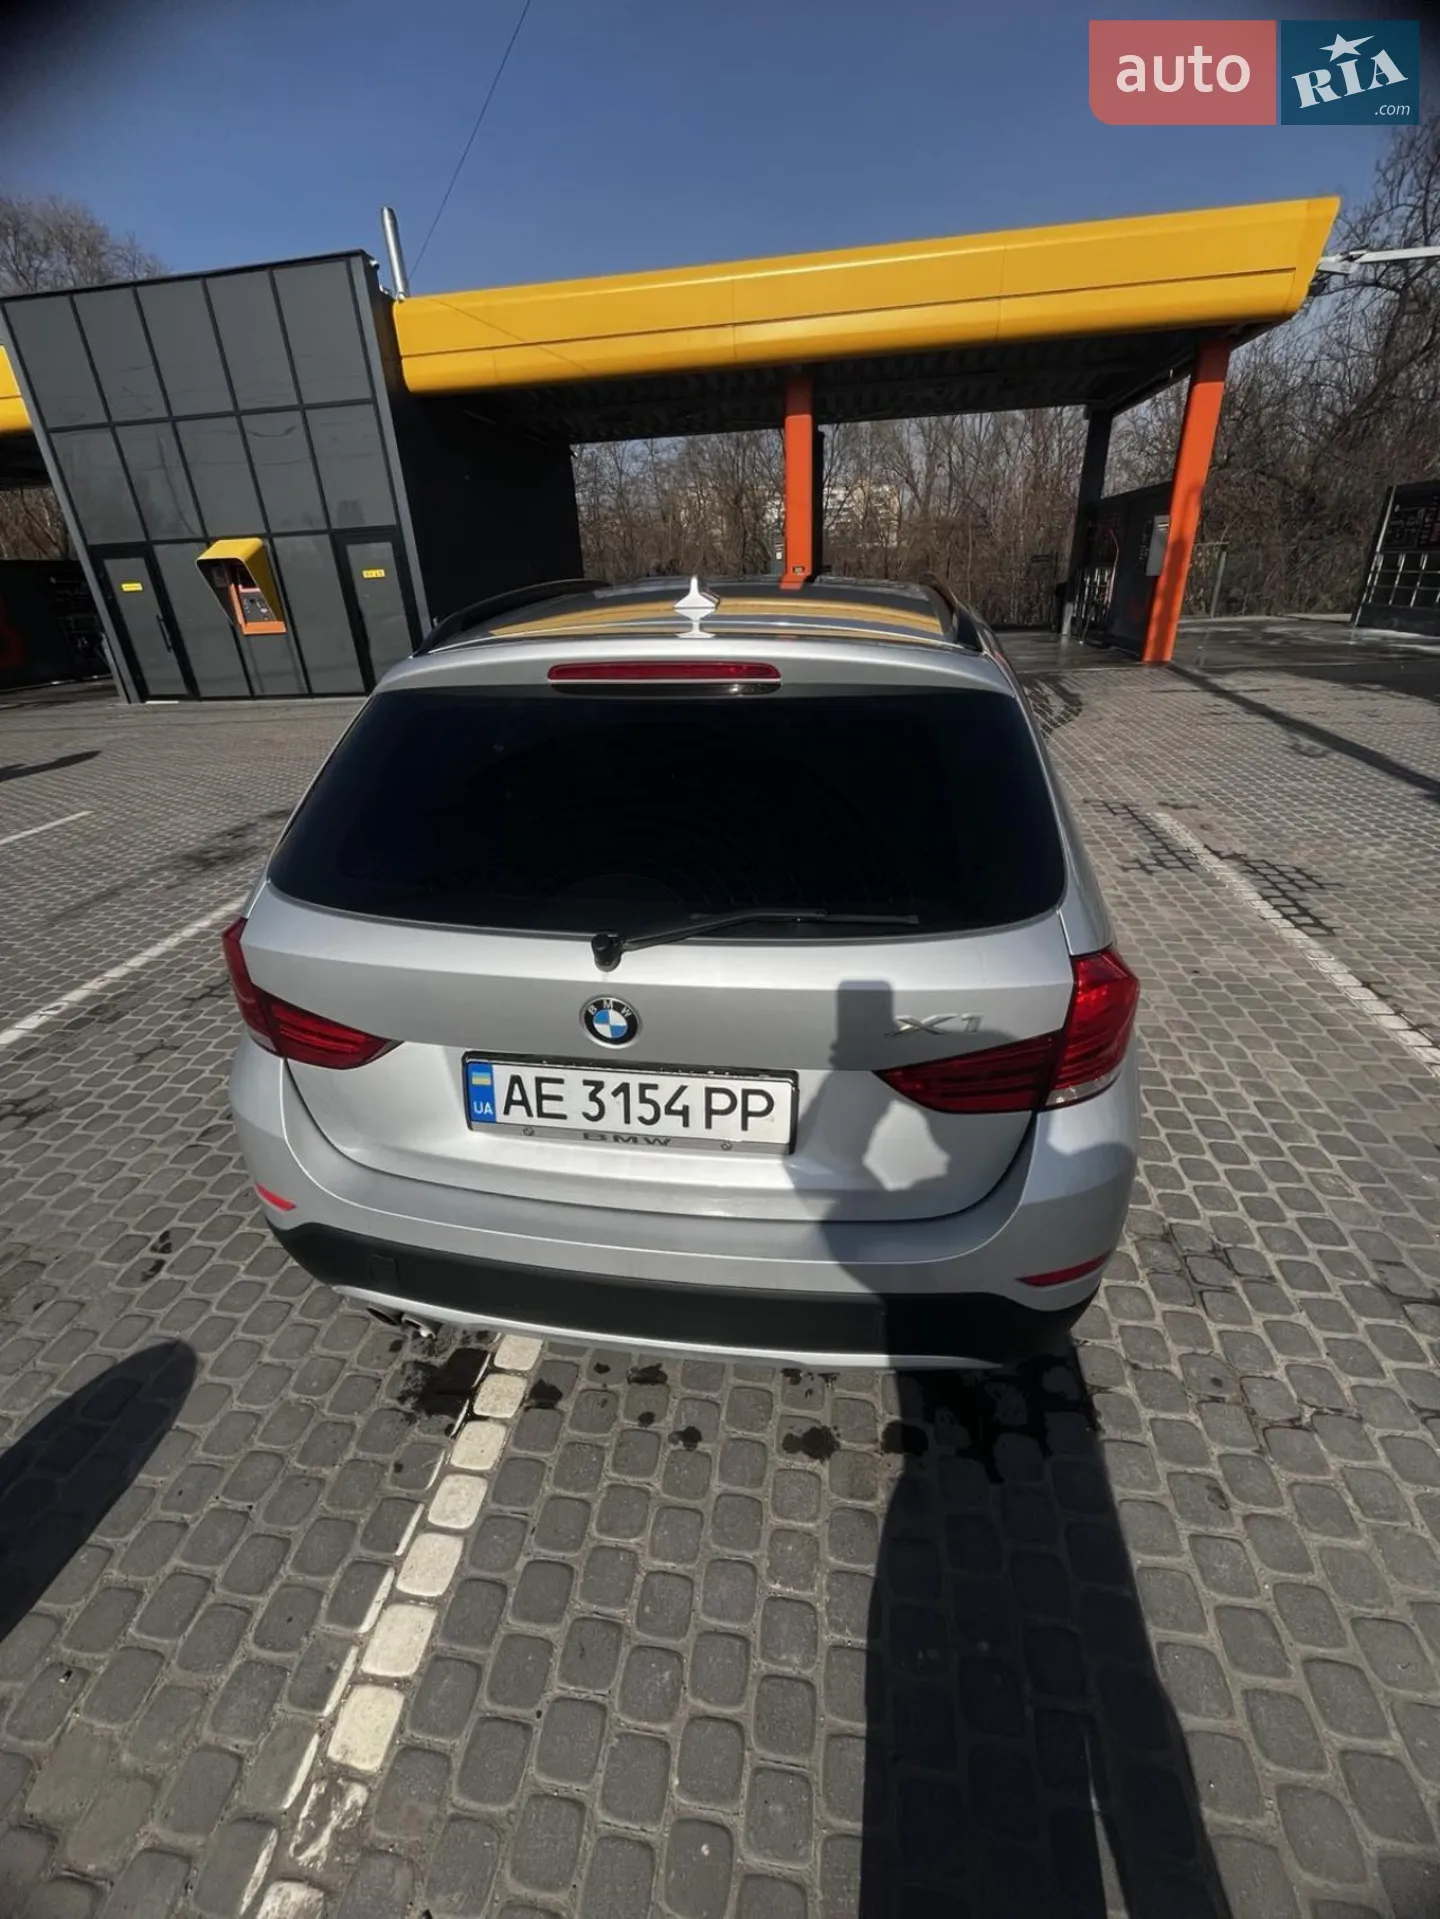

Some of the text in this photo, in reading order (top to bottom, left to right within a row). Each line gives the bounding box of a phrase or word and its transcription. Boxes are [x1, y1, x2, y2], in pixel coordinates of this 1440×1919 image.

[588, 999, 632, 1017] BMW
[884, 1012, 984, 1037] X1
[473, 1101, 493, 1116] UA
[503, 1074, 775, 1132] AE 3154 PP
[583, 1132, 672, 1147] BMW
